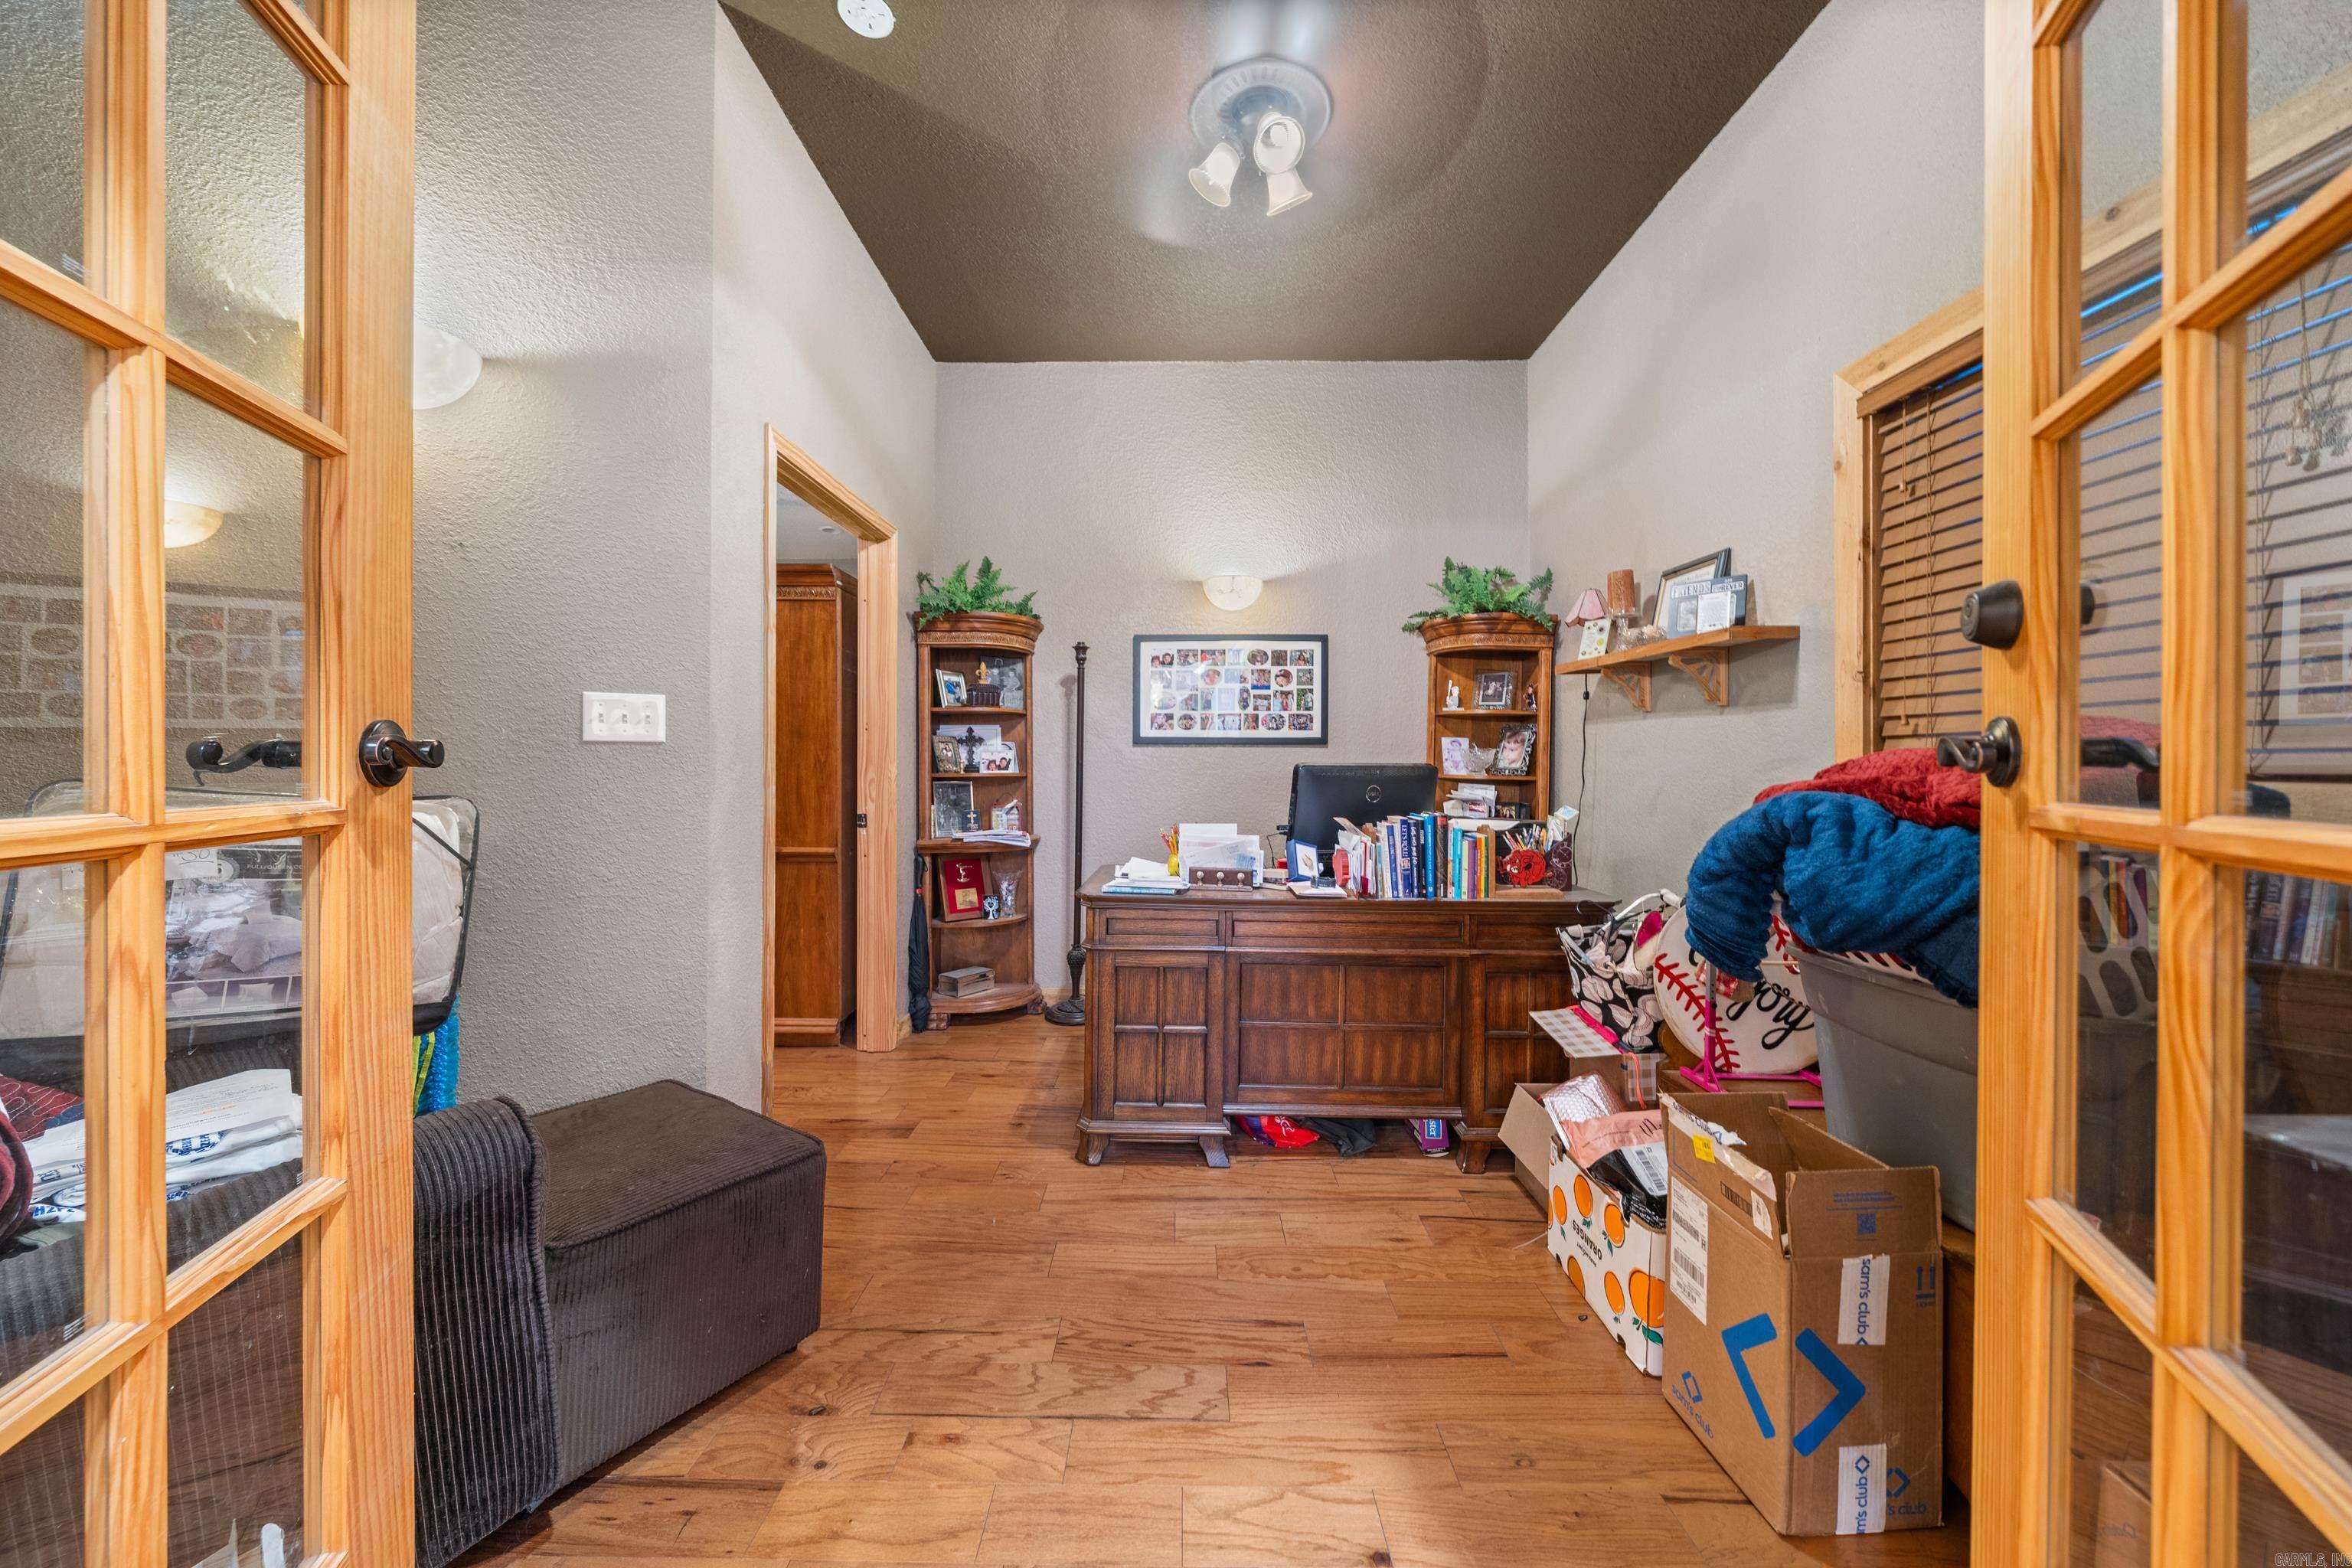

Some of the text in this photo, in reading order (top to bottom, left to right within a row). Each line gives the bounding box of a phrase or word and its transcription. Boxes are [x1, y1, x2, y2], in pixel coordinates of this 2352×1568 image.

[1572, 1220, 1602, 1261] ORANGES
[1857, 1258, 1871, 1335] sam's club
[1672, 1383, 1714, 1439] sam's club
[1855, 1476, 1868, 1508] club
[1898, 1502, 1927, 1514] club
